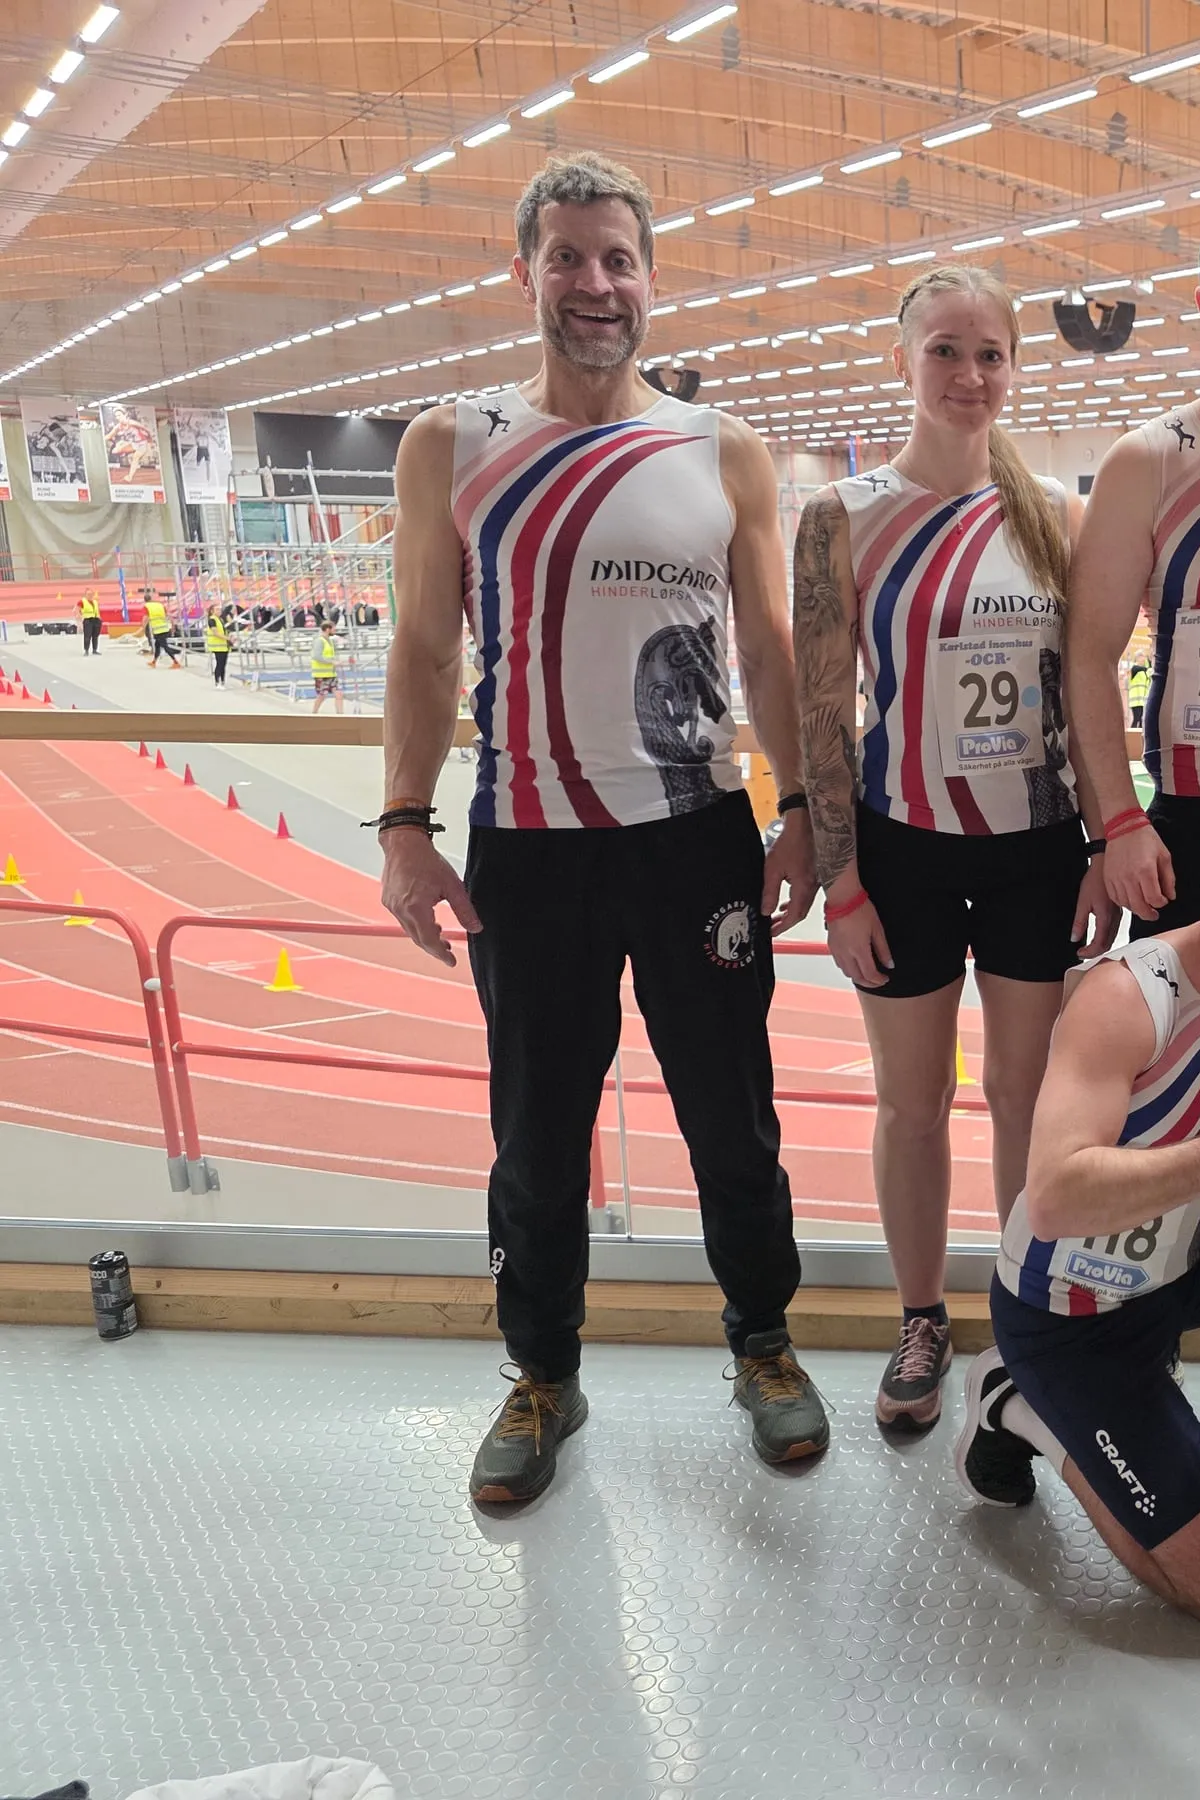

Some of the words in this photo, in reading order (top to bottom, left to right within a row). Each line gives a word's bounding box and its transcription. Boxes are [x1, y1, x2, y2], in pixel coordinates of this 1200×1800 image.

[938, 640, 986, 652] Karlstad
[988, 639, 1033, 649] inomhus
[965, 653, 1011, 666] -OCR-
[958, 671, 1019, 728] 29
[962, 737, 1017, 755] ProVia
[958, 762, 992, 771] Säkerhet
[1003, 759, 1016, 767] alla
[704, 901, 745, 932] MIDGARD
[1072, 1257, 1133, 1286] ProVia
[1095, 1429, 1147, 1494] CRAFT
